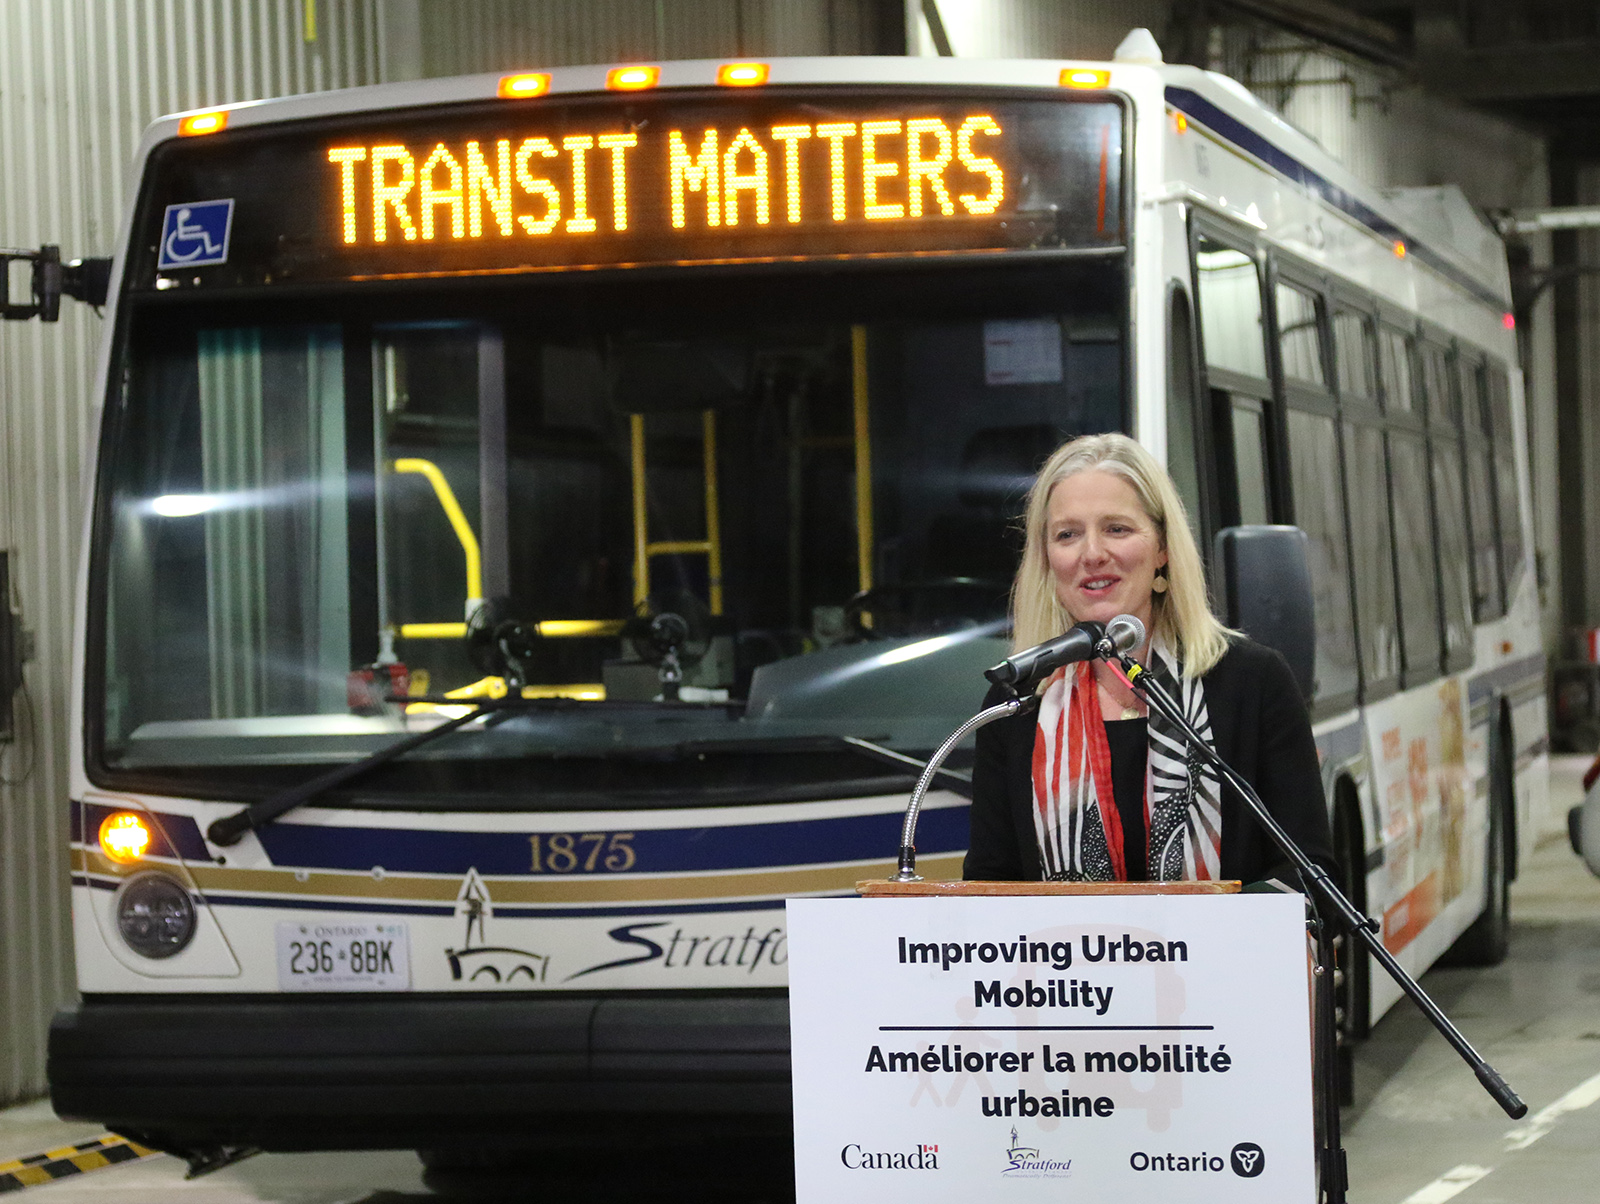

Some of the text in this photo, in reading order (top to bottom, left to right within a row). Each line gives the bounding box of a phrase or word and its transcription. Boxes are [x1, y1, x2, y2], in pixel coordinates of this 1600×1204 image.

[328, 115, 1005, 244] TRANSIT MATTERS
[528, 833, 637, 873] 1875
[289, 941, 394, 974] 236 8BK
[898, 934, 1188, 971] Improving Urban
[974, 980, 1114, 1016] Mobility
[864, 1044, 1232, 1073] Améliorer la mobilité
[981, 1089, 1115, 1118] urbaine
[841, 1144, 940, 1170] Canada
[1001, 1159, 1072, 1174] Stratford
[1129, 1151, 1225, 1173] Ontario
